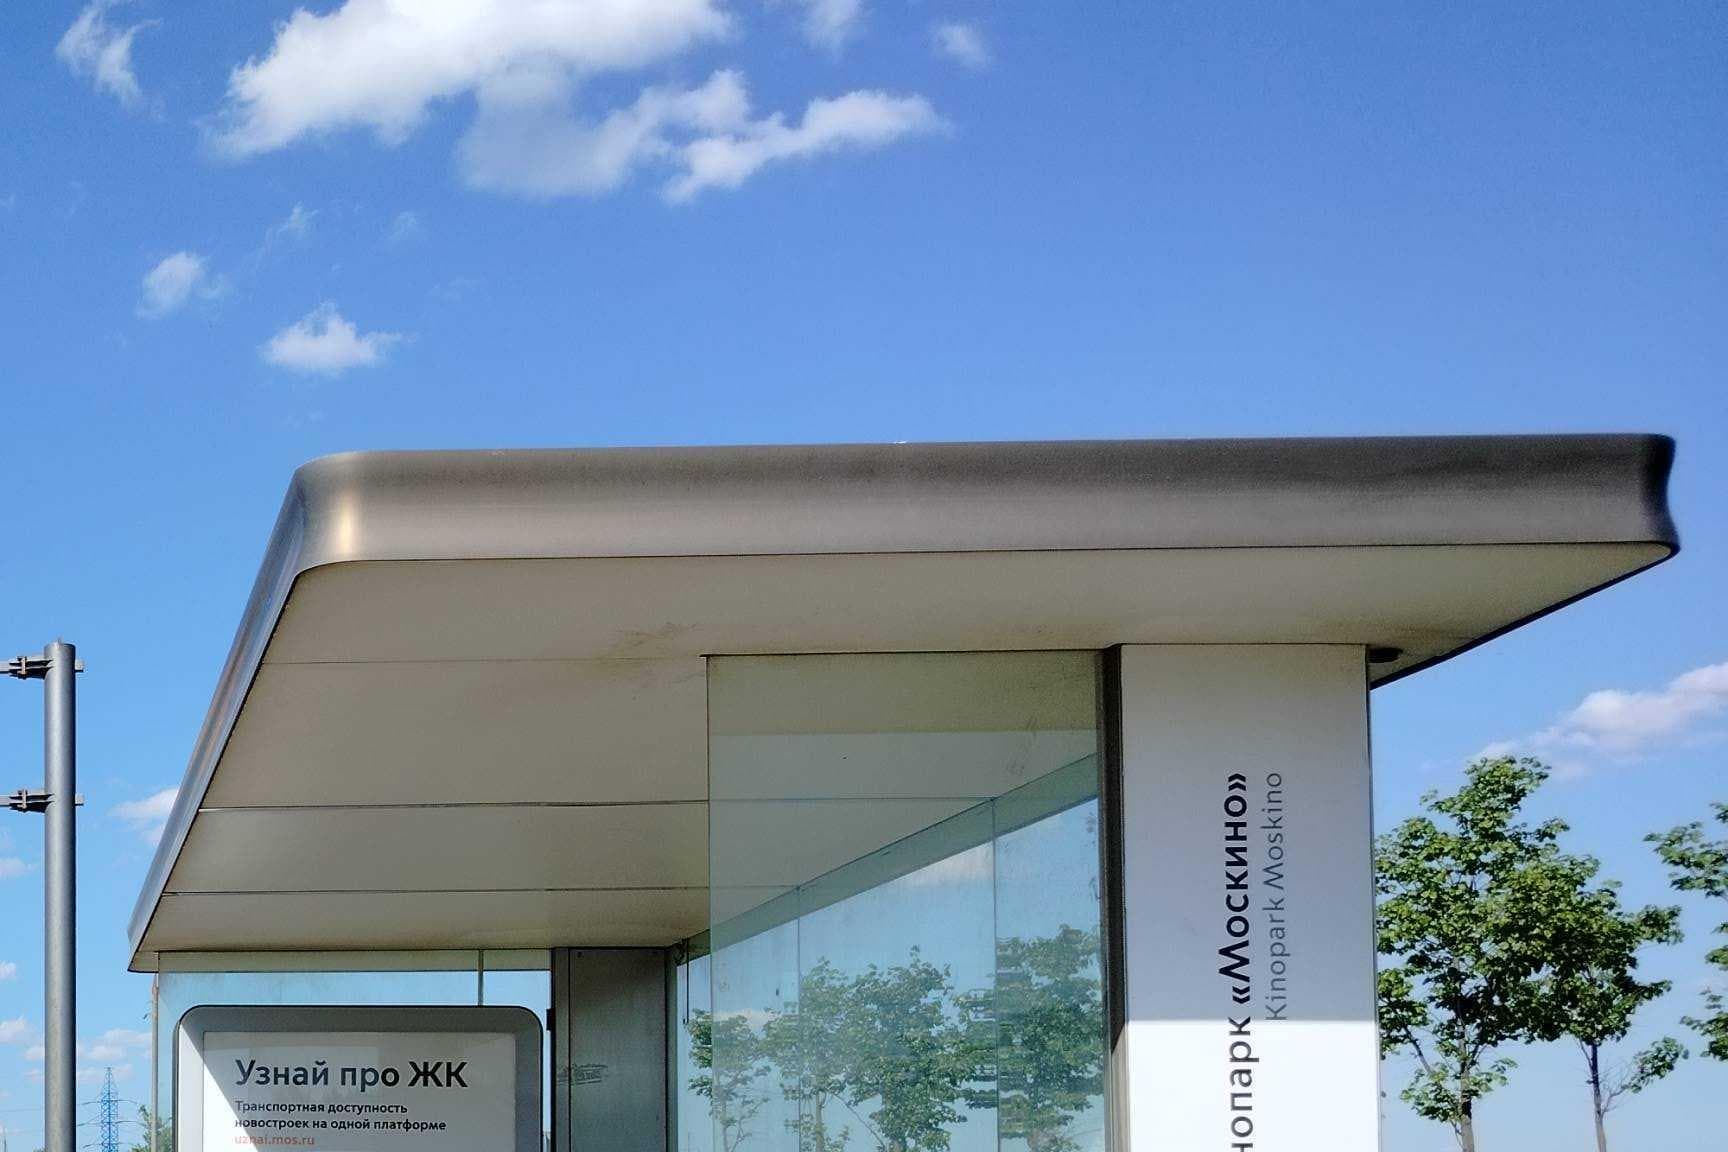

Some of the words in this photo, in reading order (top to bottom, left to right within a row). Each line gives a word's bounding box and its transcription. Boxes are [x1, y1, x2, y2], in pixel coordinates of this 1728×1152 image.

[1258, 771, 1286, 889] Moskino
[1218, 772, 1251, 1004] «Москино»
[1262, 897, 1291, 1021] Kinopark
[235, 1059, 329, 1087] Узнай
[340, 1067, 400, 1092] про
[407, 1061, 469, 1088] ЖК
[234, 1118, 310, 1131] новостроек
[312, 1119, 328, 1130] на
[330, 1118, 371, 1131] одной
[373, 1118, 447, 1133] платформе
[235, 1100, 325, 1118] Транспортная
[327, 1103, 408, 1117] доступность
[234, 1134, 315, 1147] uznai.mos.ru
